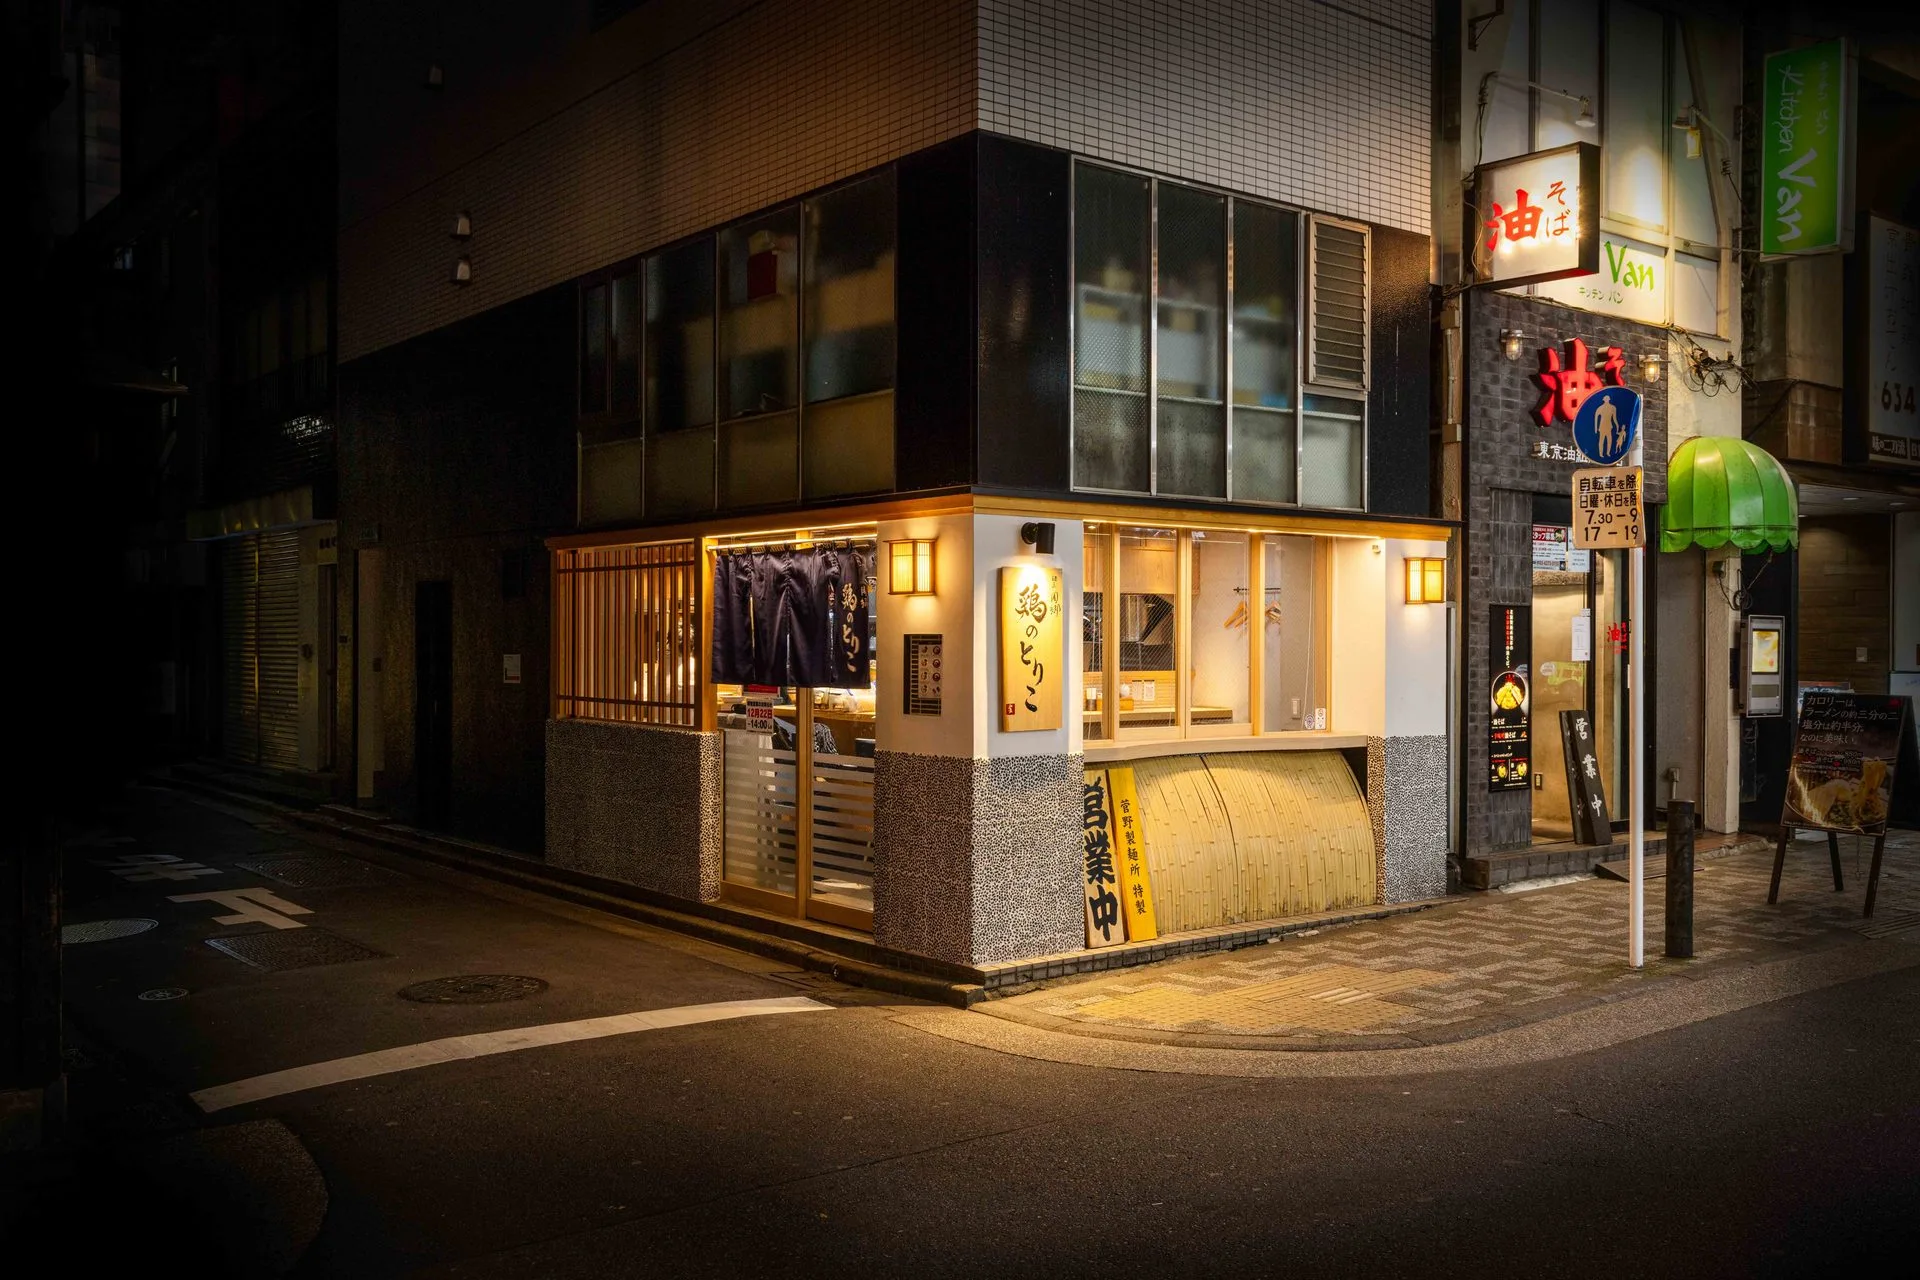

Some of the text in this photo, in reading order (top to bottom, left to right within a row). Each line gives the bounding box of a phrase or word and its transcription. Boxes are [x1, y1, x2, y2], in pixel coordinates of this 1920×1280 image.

[1773, 64, 1818, 243] Kitchen Van
[1484, 188, 1544, 252] 油
[1546, 181, 1571, 238] そば
[1604, 241, 1655, 291] Van
[1881, 381, 1916, 414] 634
[748, 707, 772, 719] 12月22日
[1575, 717, 1603, 817] 営業中
[1084, 776, 1118, 942] 営業中
[1133, 883, 1147, 914] 特製
